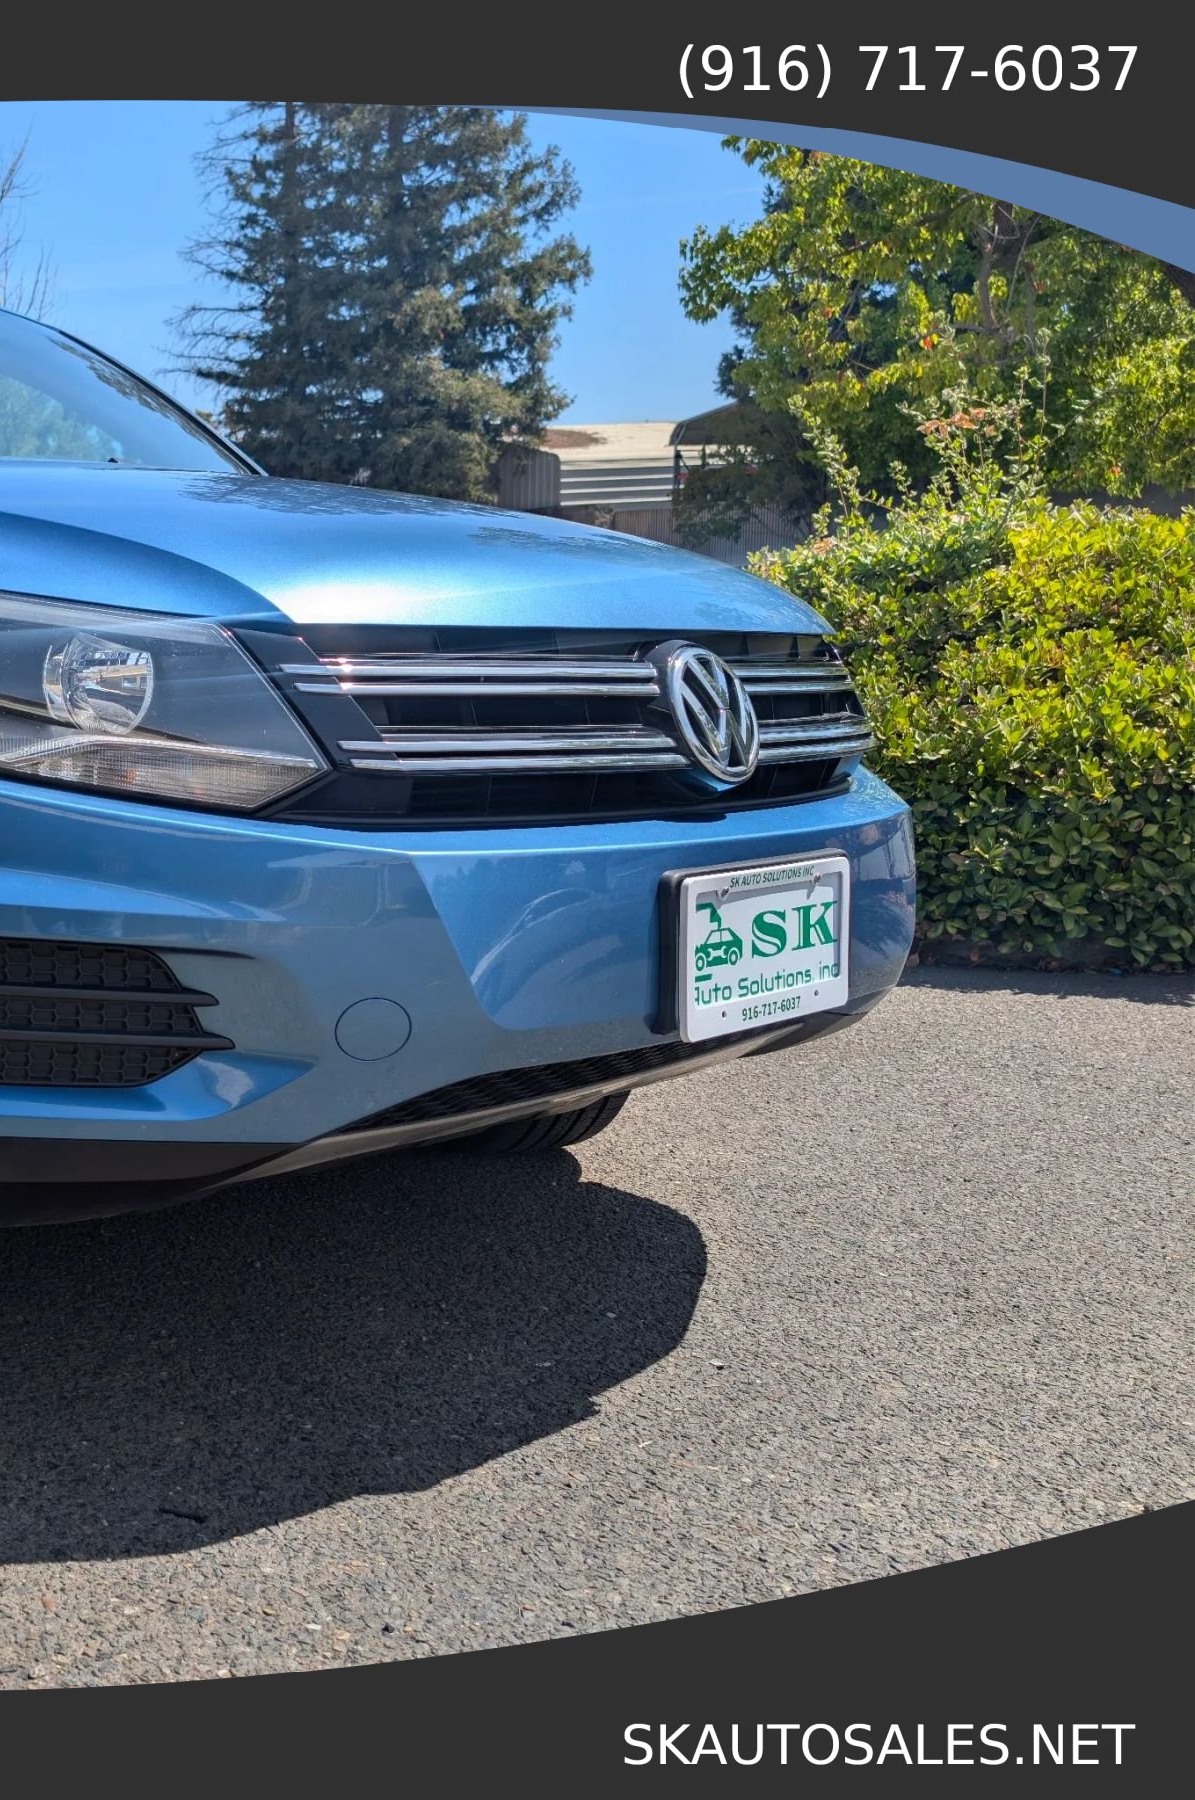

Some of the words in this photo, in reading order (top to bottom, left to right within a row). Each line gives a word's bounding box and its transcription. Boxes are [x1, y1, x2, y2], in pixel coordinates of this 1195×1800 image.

[730, 877, 740, 889] SK
[741, 873, 763, 887] AUTO
[762, 867, 802, 884] SOLUTIONS
[803, 865, 815, 878] INC
[751, 901, 837, 958] SK
[742, 995, 801, 1021] 916-717-6037
